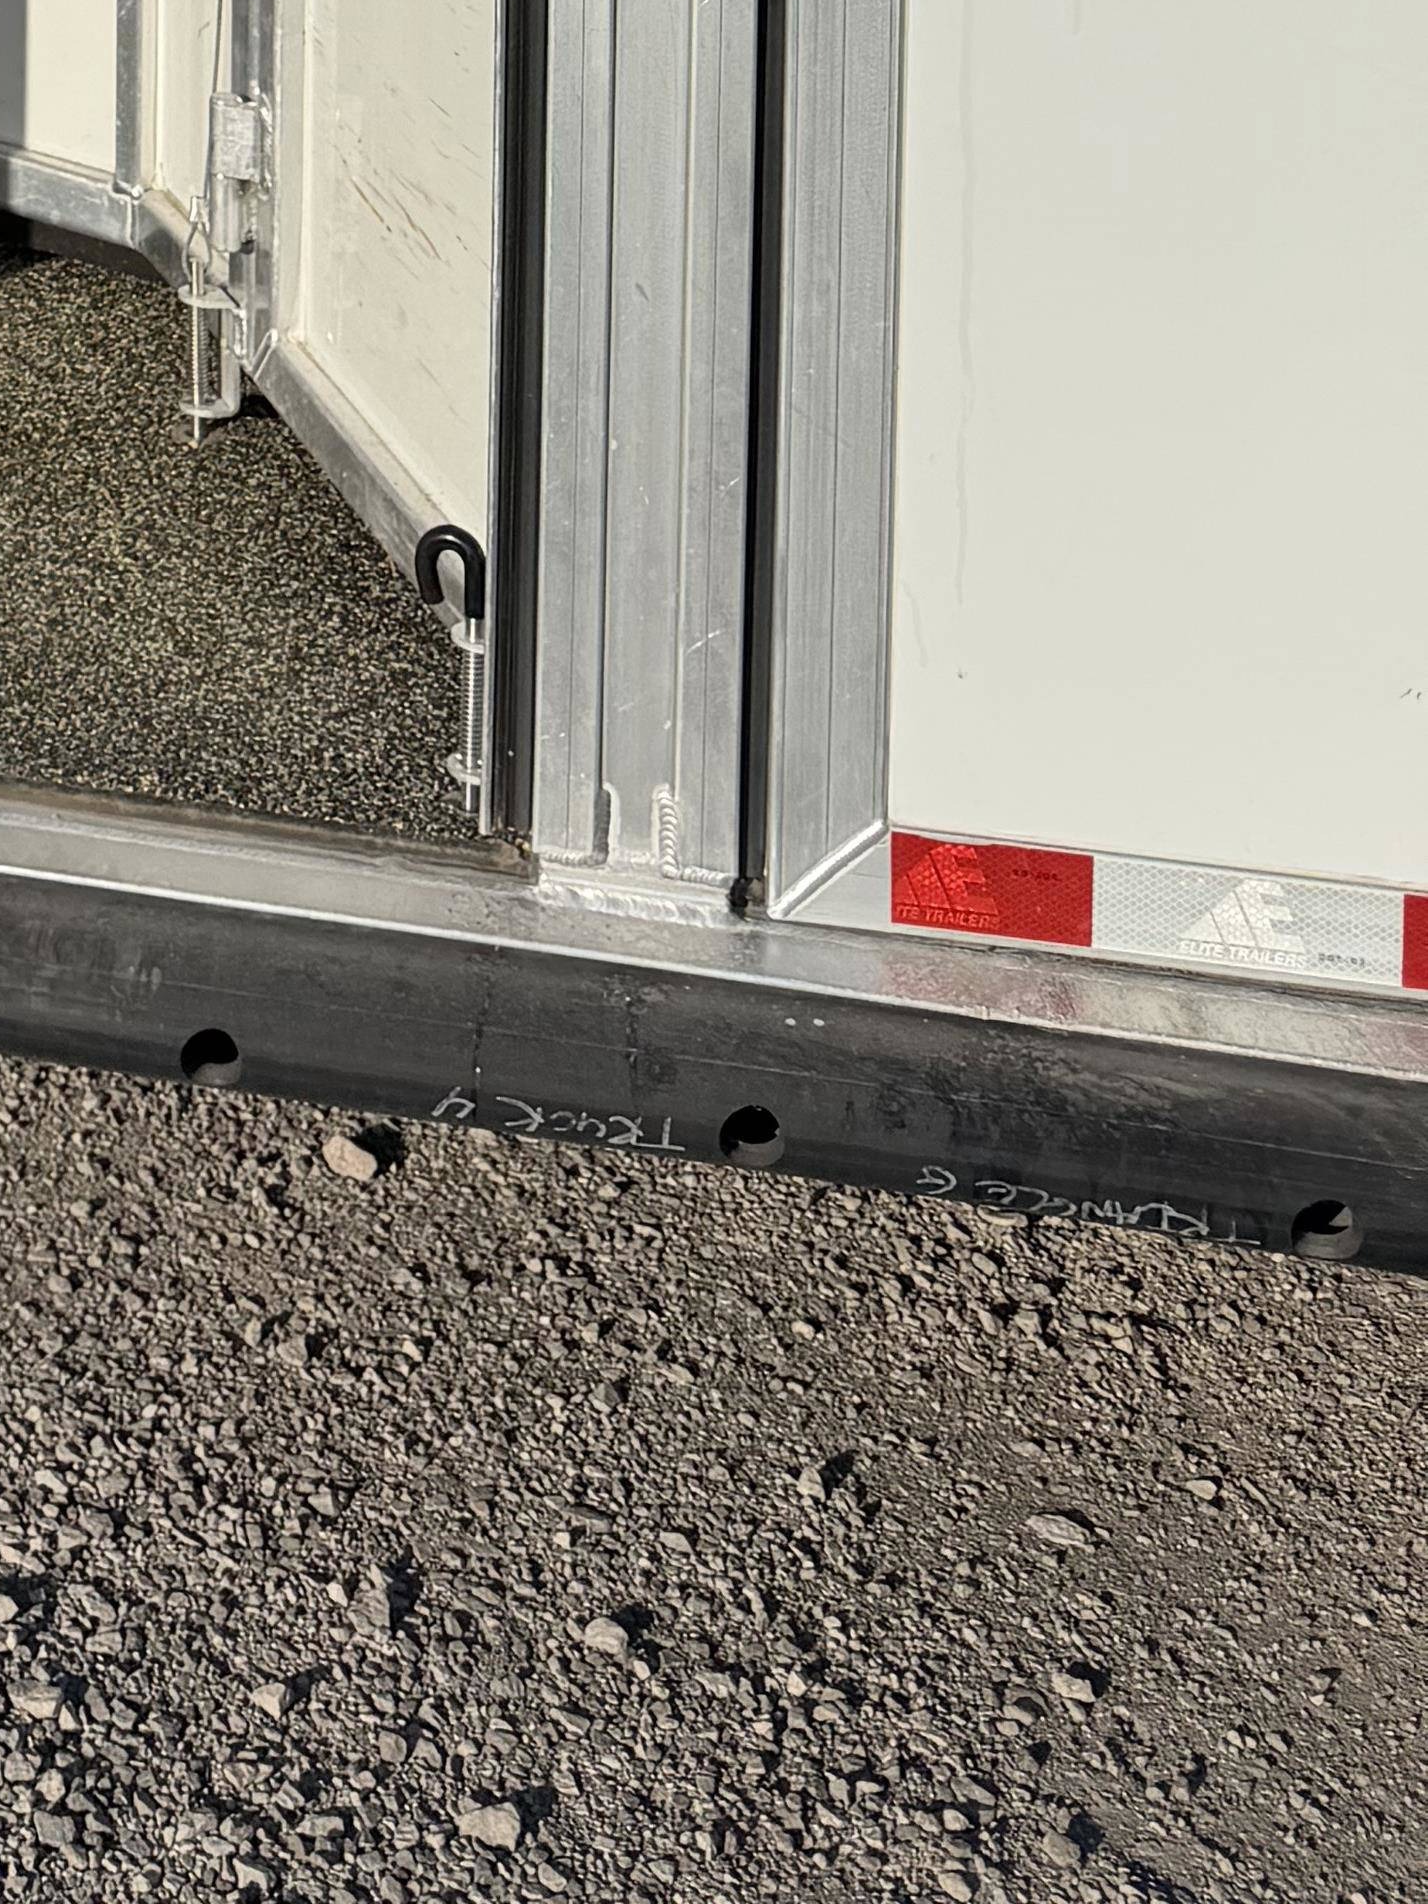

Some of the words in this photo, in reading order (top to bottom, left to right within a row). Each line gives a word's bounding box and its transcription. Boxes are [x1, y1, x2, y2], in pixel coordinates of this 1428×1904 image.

[1178, 940, 1225, 959] ELITE
[1229, 946, 1309, 968] TRAILERS
[495, 1095, 686, 1152] TRUCK
